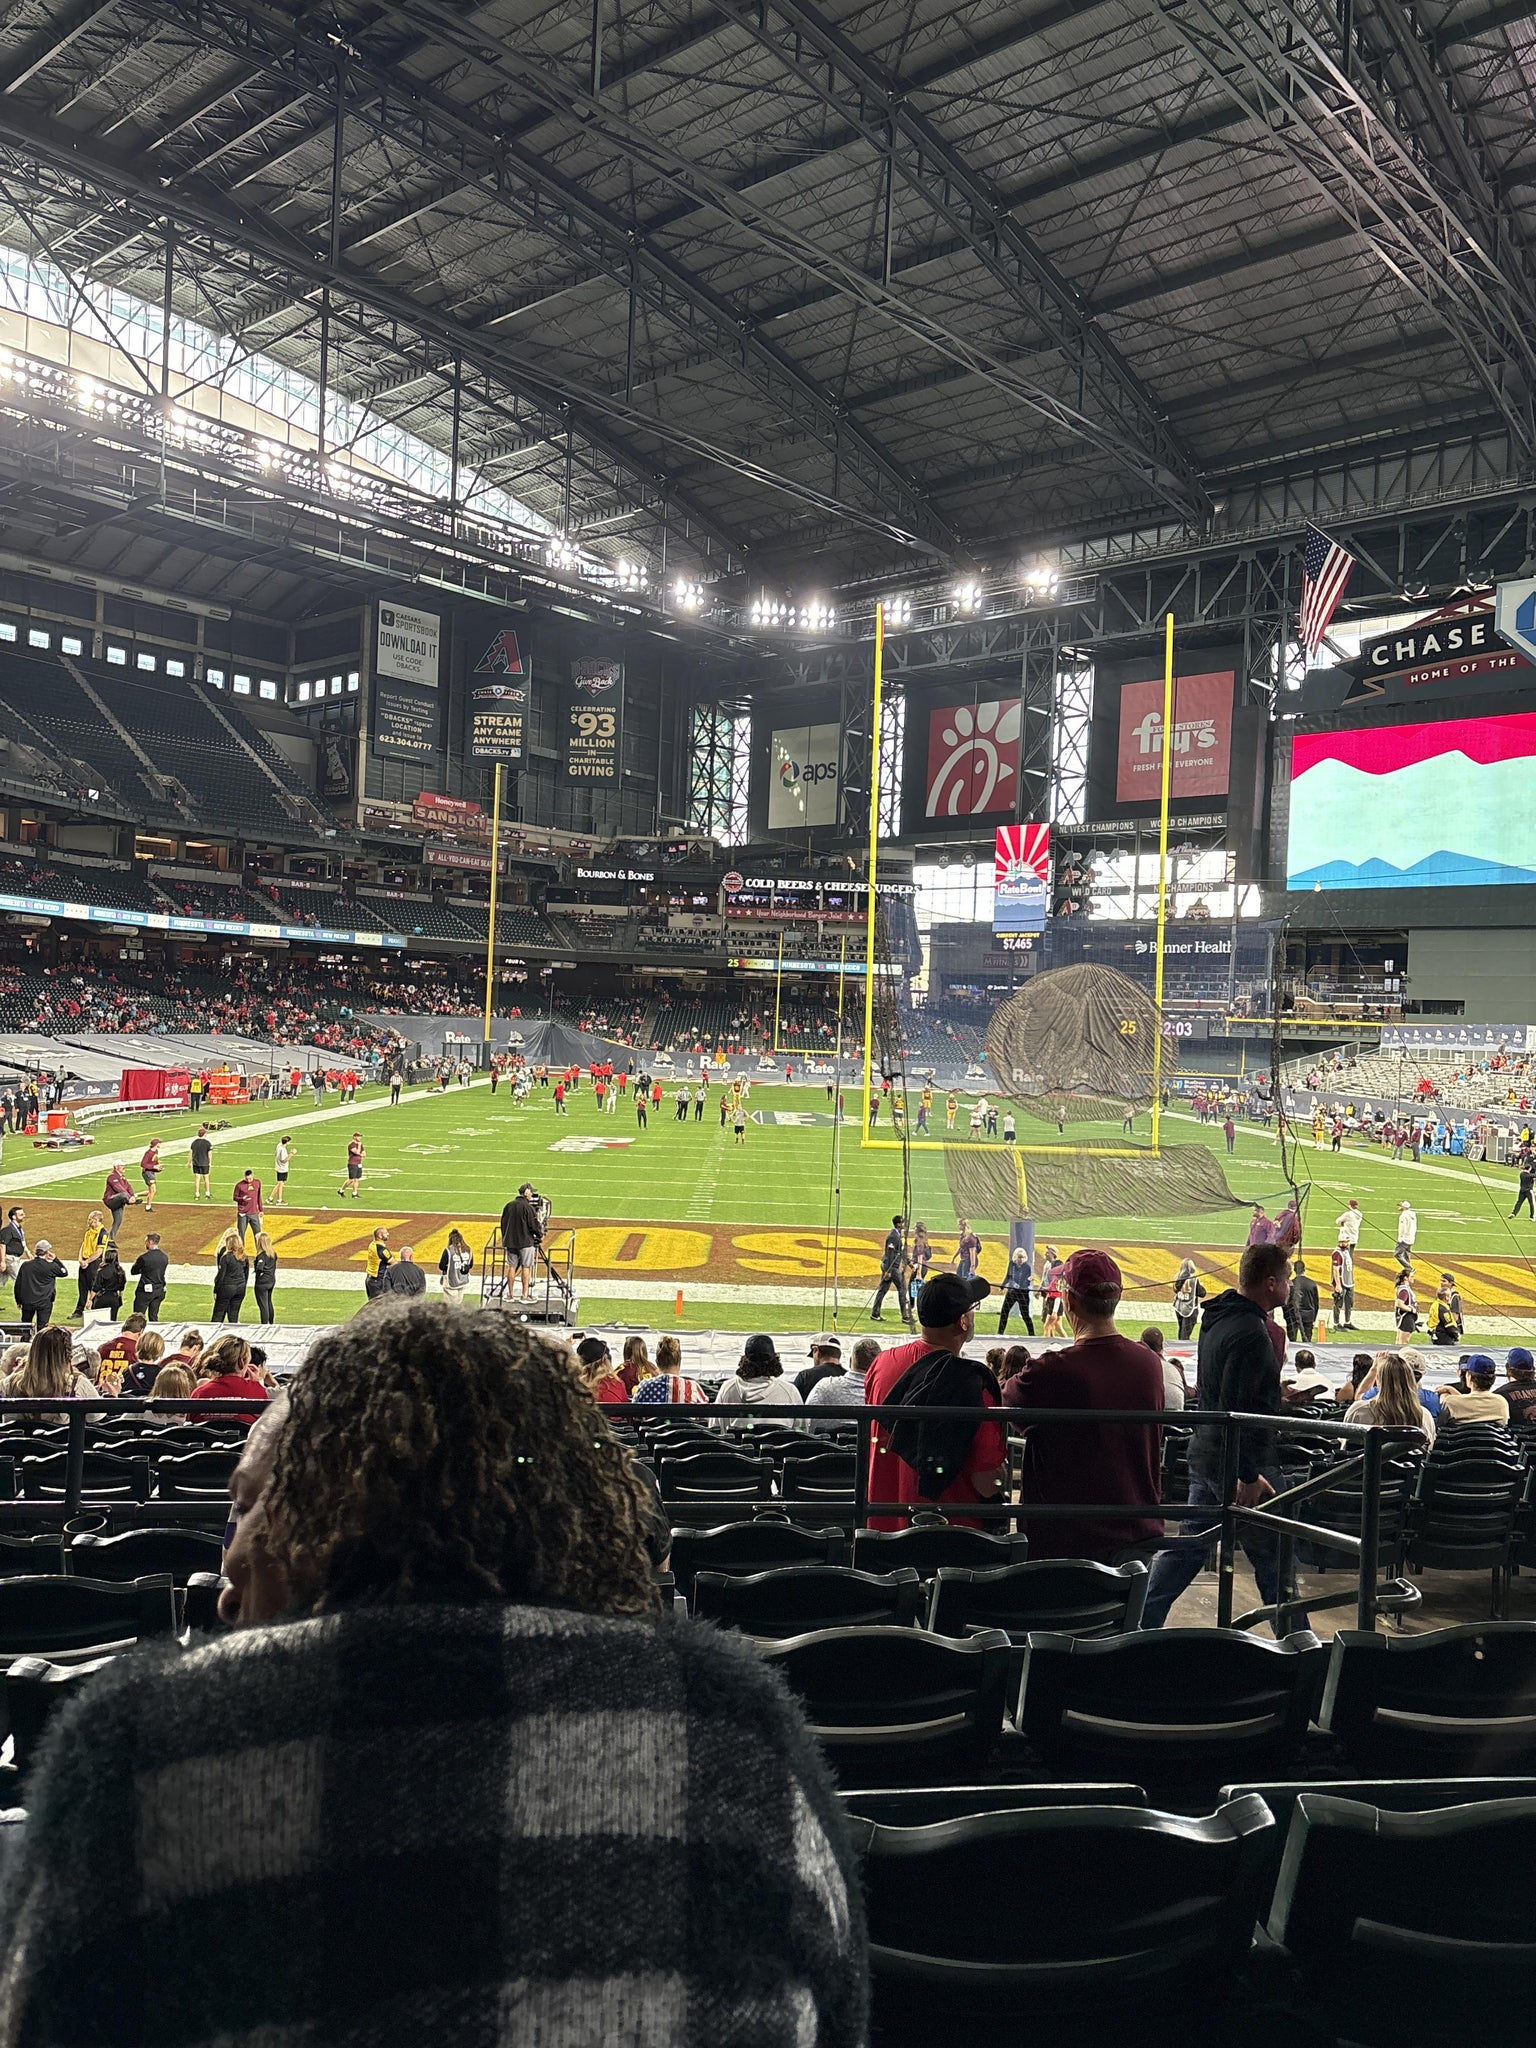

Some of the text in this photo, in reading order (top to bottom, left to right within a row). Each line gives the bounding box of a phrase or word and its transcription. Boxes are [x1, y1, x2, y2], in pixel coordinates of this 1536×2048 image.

[396, 613, 421, 624] CAESARS
[396, 620, 438, 638] SPORTSBOOK
[380, 631, 437, 659] DOWNLOAD IT
[1371, 624, 1485, 666] CHASE
[393, 653, 404, 661] USE
[396, 661, 421, 673] DBACKS
[1410, 656, 1517, 684] HOME OF THE
[575, 675, 613, 689] Give Back
[380, 691, 398, 701] Report
[570, 705, 617, 713] CELEBRATING
[391, 721, 423, 734] LOCATION
[473, 716, 522, 727] STREAM
[570, 712, 616, 738] $93
[1178, 720, 1212, 731] STORES
[473, 727, 522, 737] ANY GAME
[378, 733, 433, 751] 623.304.0777
[473, 736, 522, 746] ANYWHERE
[569, 738, 616, 748] MILLION
[568, 757, 615, 765] CHARITABLE
[1132, 763, 1156, 773] FRESH
[1175, 758, 1214, 769] EVERYONE
[568, 765, 615, 777] GIVING
[802, 762, 837, 786] aps
[434, 796, 467, 809] Honeywell
[417, 807, 484, 830] SANDLOT
[1150, 815, 1223, 829] WOD CHAMPIONS
[1091, 821, 1135, 832] CHAMPIONS
[617, 869, 627, 880] &
[291, 881, 311, 889] BAR-S
[745, 878, 775, 888] COLD
[776, 880, 814, 890] BEERS
[814, 881, 823, 891] &
[823, 881, 921, 894] CHEESEURGERS
[1166, 883, 1214, 893] CHAMPIONS
[386, 890, 404, 898] BAR-S
[1071, 887, 1112, 896] WID CARD
[756, 908, 770, 918] Your
[771, 908, 806, 919] Neighborhood
[1003, 938, 1032, 950] $7,465
[1149, 941, 1192, 954] Bnner
[727, 958, 740, 968] 25
[781, 961, 816, 969] MINNESOTA
[1120, 1020, 1137, 1034] 25
[445, 1027, 472, 1044] Rate
[806, 1060, 835, 1075] Rate
